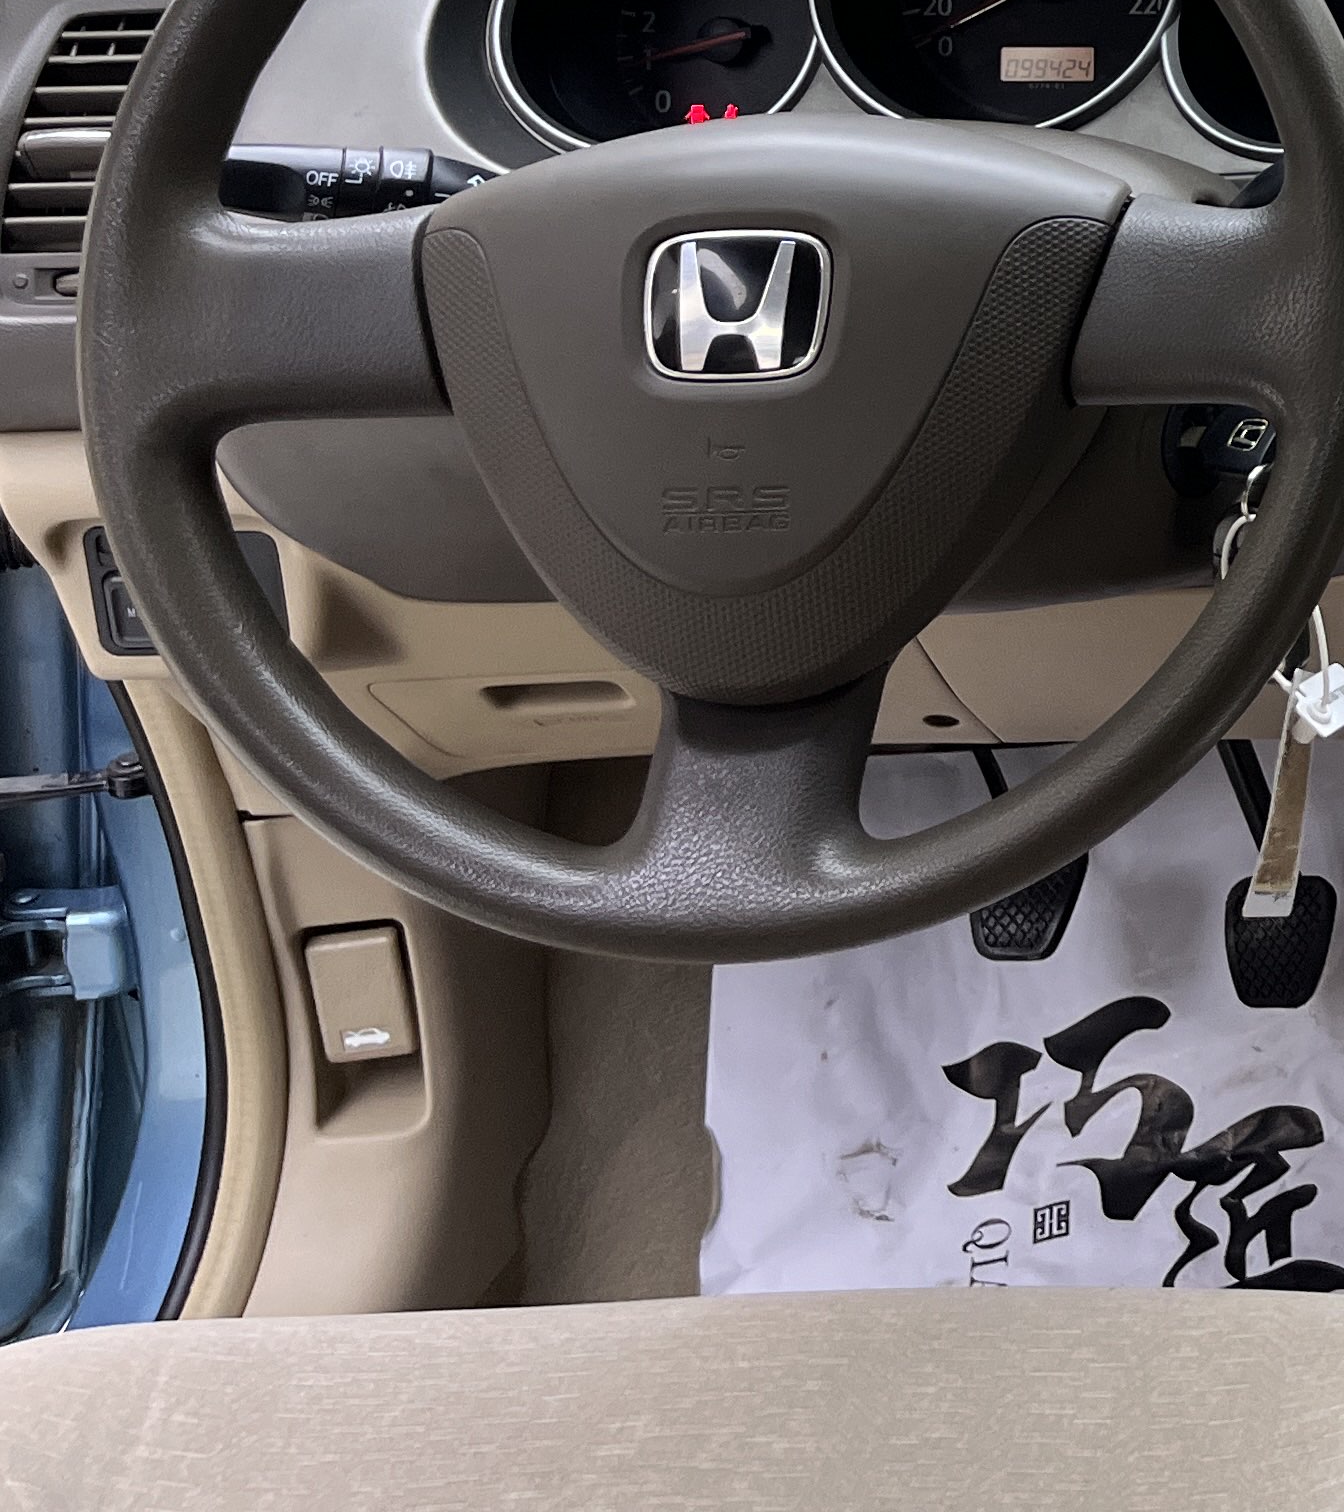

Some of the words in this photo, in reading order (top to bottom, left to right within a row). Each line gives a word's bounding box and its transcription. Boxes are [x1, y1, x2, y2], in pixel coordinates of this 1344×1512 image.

[642, 10, 656, 33] 2
[937, 36, 953, 57] 0
[1004, 59, 1092, 78] 099424
[655, 90, 672, 113] 0
[305, 170, 339, 187] OFF
[661, 486, 792, 513] SRS
